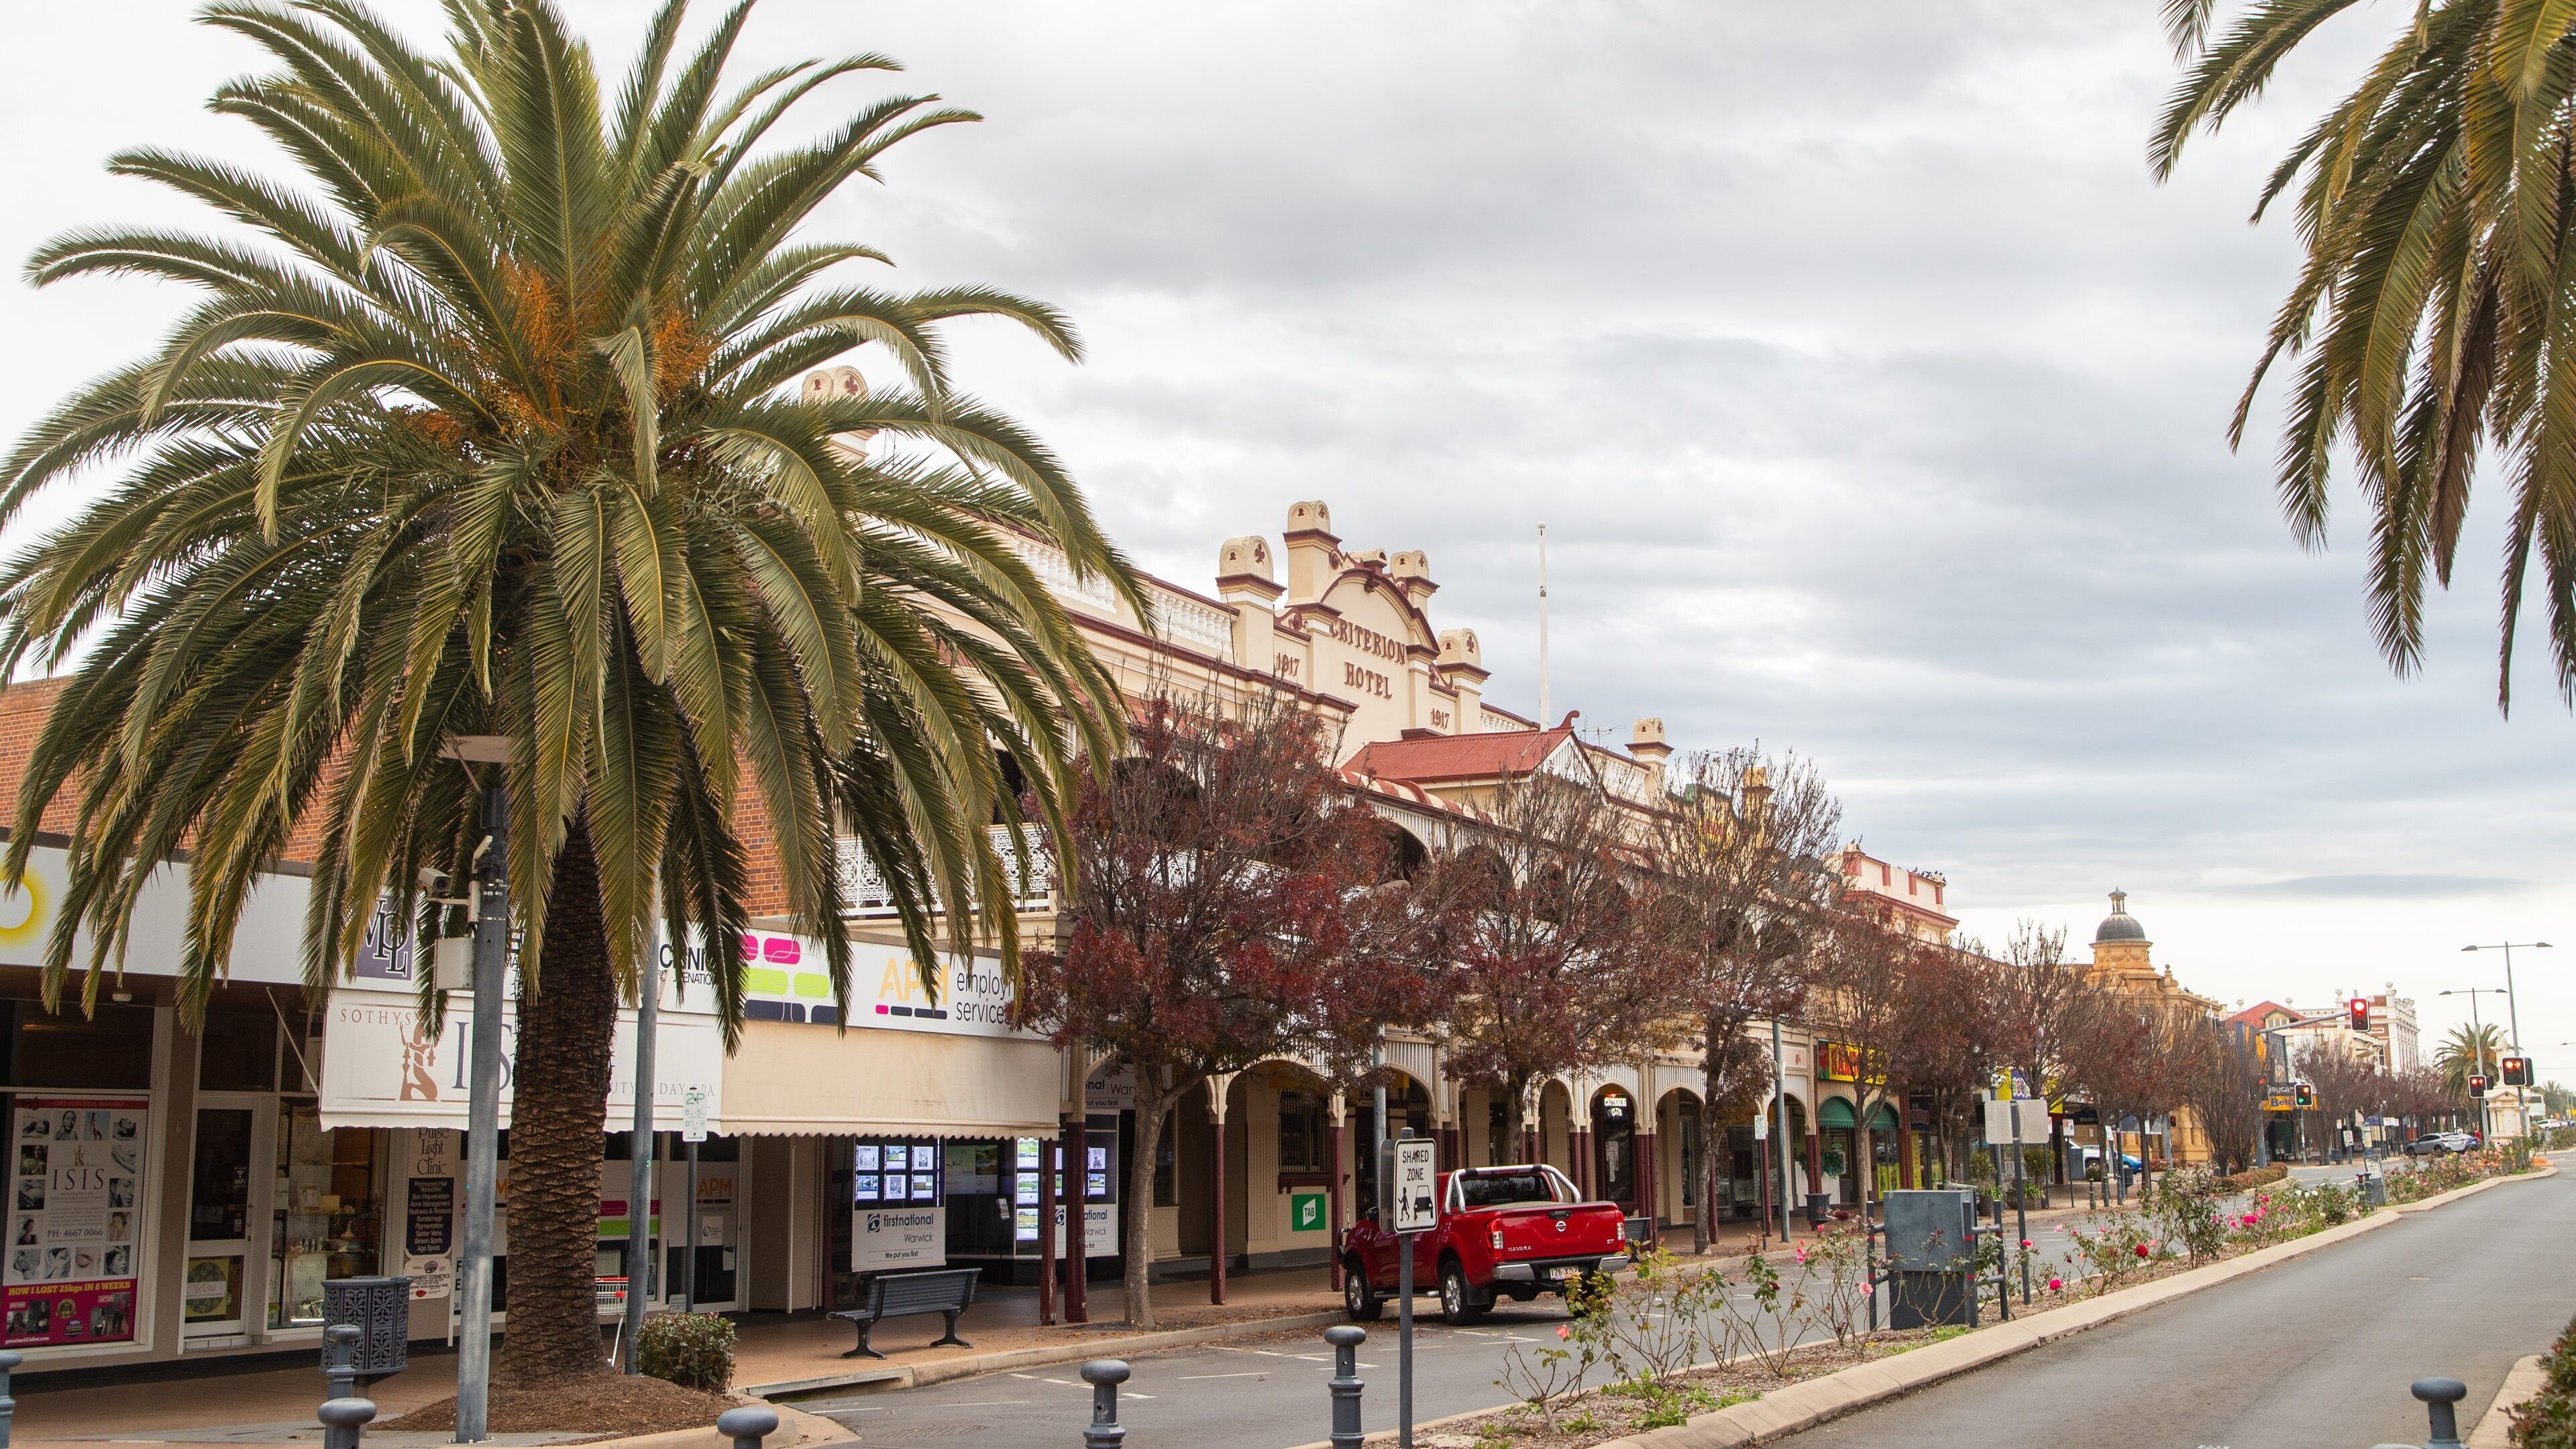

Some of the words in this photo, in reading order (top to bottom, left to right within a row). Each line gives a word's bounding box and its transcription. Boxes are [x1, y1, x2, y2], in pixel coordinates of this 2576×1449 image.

[1330, 618, 1406, 664] CRITERION
[1275, 652, 1300, 676] 1917
[1344, 662, 1393, 699] HOTEL
[1431, 708, 1450, 729] 1917
[957, 969, 1014, 1000] employ
[341, 1008, 411, 1026] SOTHYS
[660, 1083, 685, 1095] DAY
[693, 1083, 714, 1096] PA
[686, 1093, 705, 1105] 2P
[421, 1139, 445, 1160] Light
[1403, 1150, 1429, 1163] SHARED
[417, 1159, 447, 1175] Clinic
[1407, 1168, 1424, 1181] ZONE
[52, 1168, 105, 1190] ISIS
[698, 1177, 732, 1197] APM
[883, 1213, 934, 1227] firstnational
[1084, 1209, 1108, 1220] ational
[1304, 1208, 1315, 1217] TAB
[904, 1233, 933, 1242] Warwick
[1552, 1268, 1562, 1277] 126
[9, 1287, 29, 1296] HOW
[36, 1286, 58, 1294] LOST
[60, 1285, 83, 1293] 25kgs
[84, 1283, 93, 1291] IN
[101, 1281, 131, 1290] WEEKS
